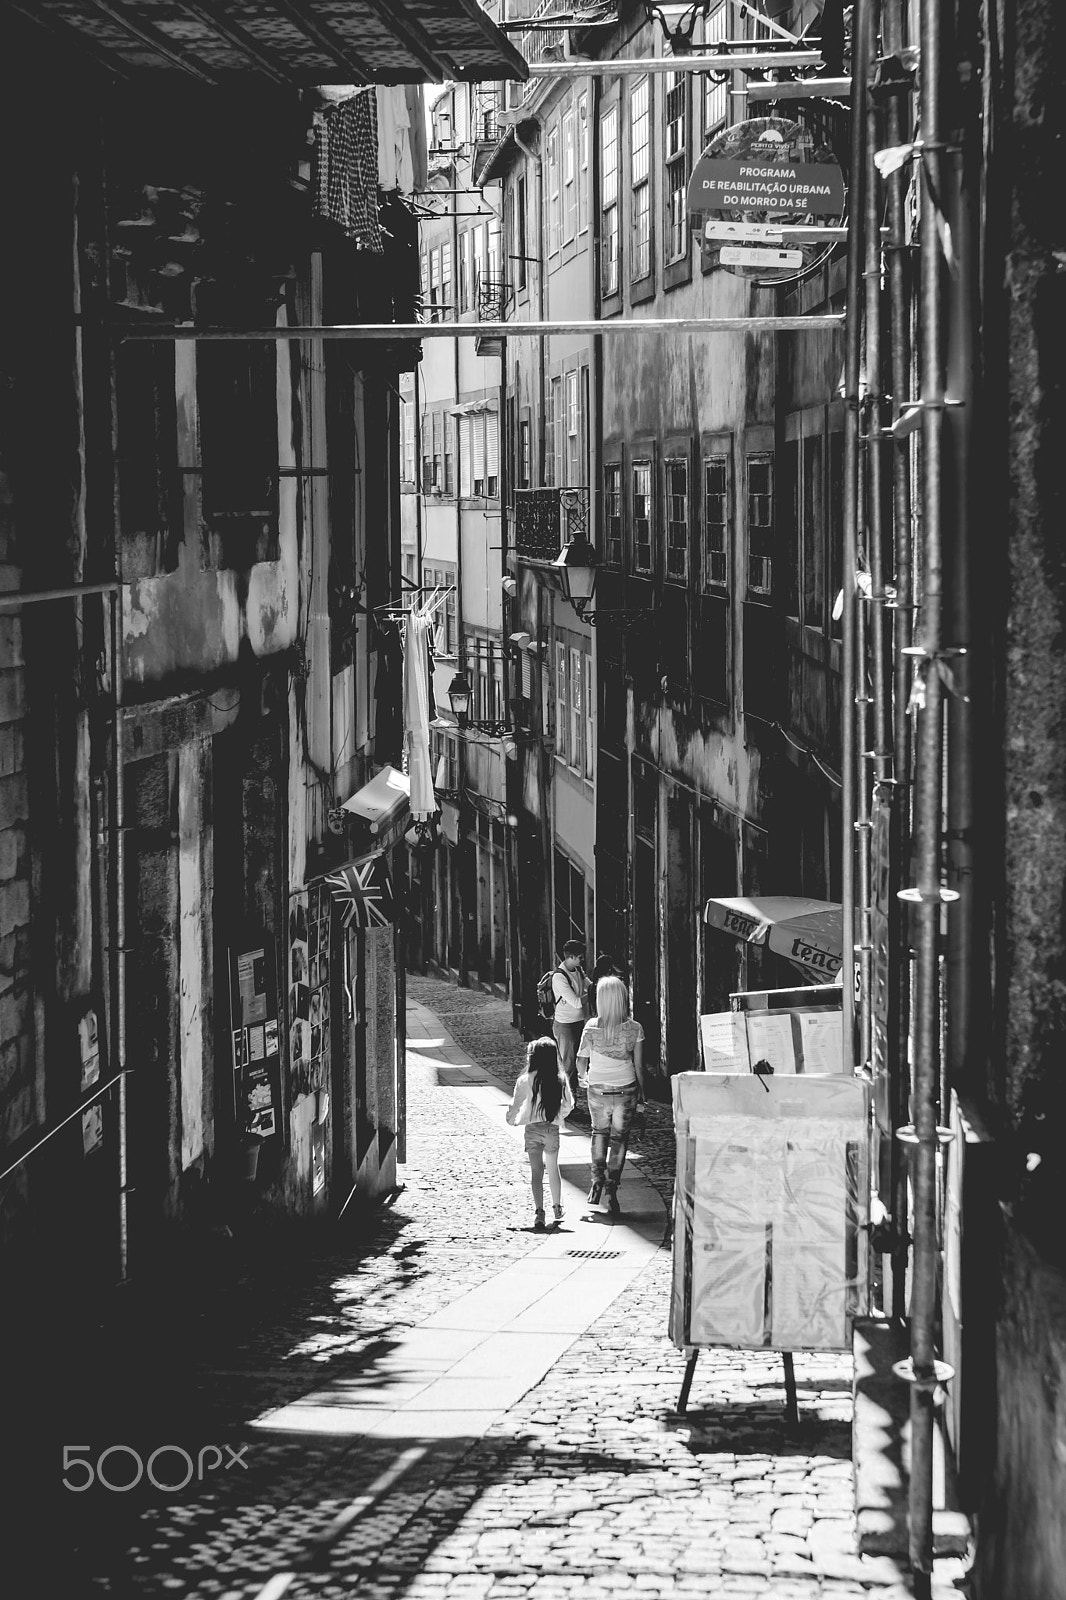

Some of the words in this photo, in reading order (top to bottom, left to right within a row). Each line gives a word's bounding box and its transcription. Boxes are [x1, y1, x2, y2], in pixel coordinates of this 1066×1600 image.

[740, 167, 796, 178] PROGRAMA
[702, 180, 716, 190] DE
[717, 181, 788, 194] REABILITAÇÃO
[789, 184, 831, 195] URBANA
[723, 195, 739, 204] DO
[740, 196, 778, 207] MORRO
[779, 198, 794, 207] DA
[795, 197, 808, 208] SÉ
[724, 909, 755, 937] tenc
[791, 938, 840, 971] tenc
